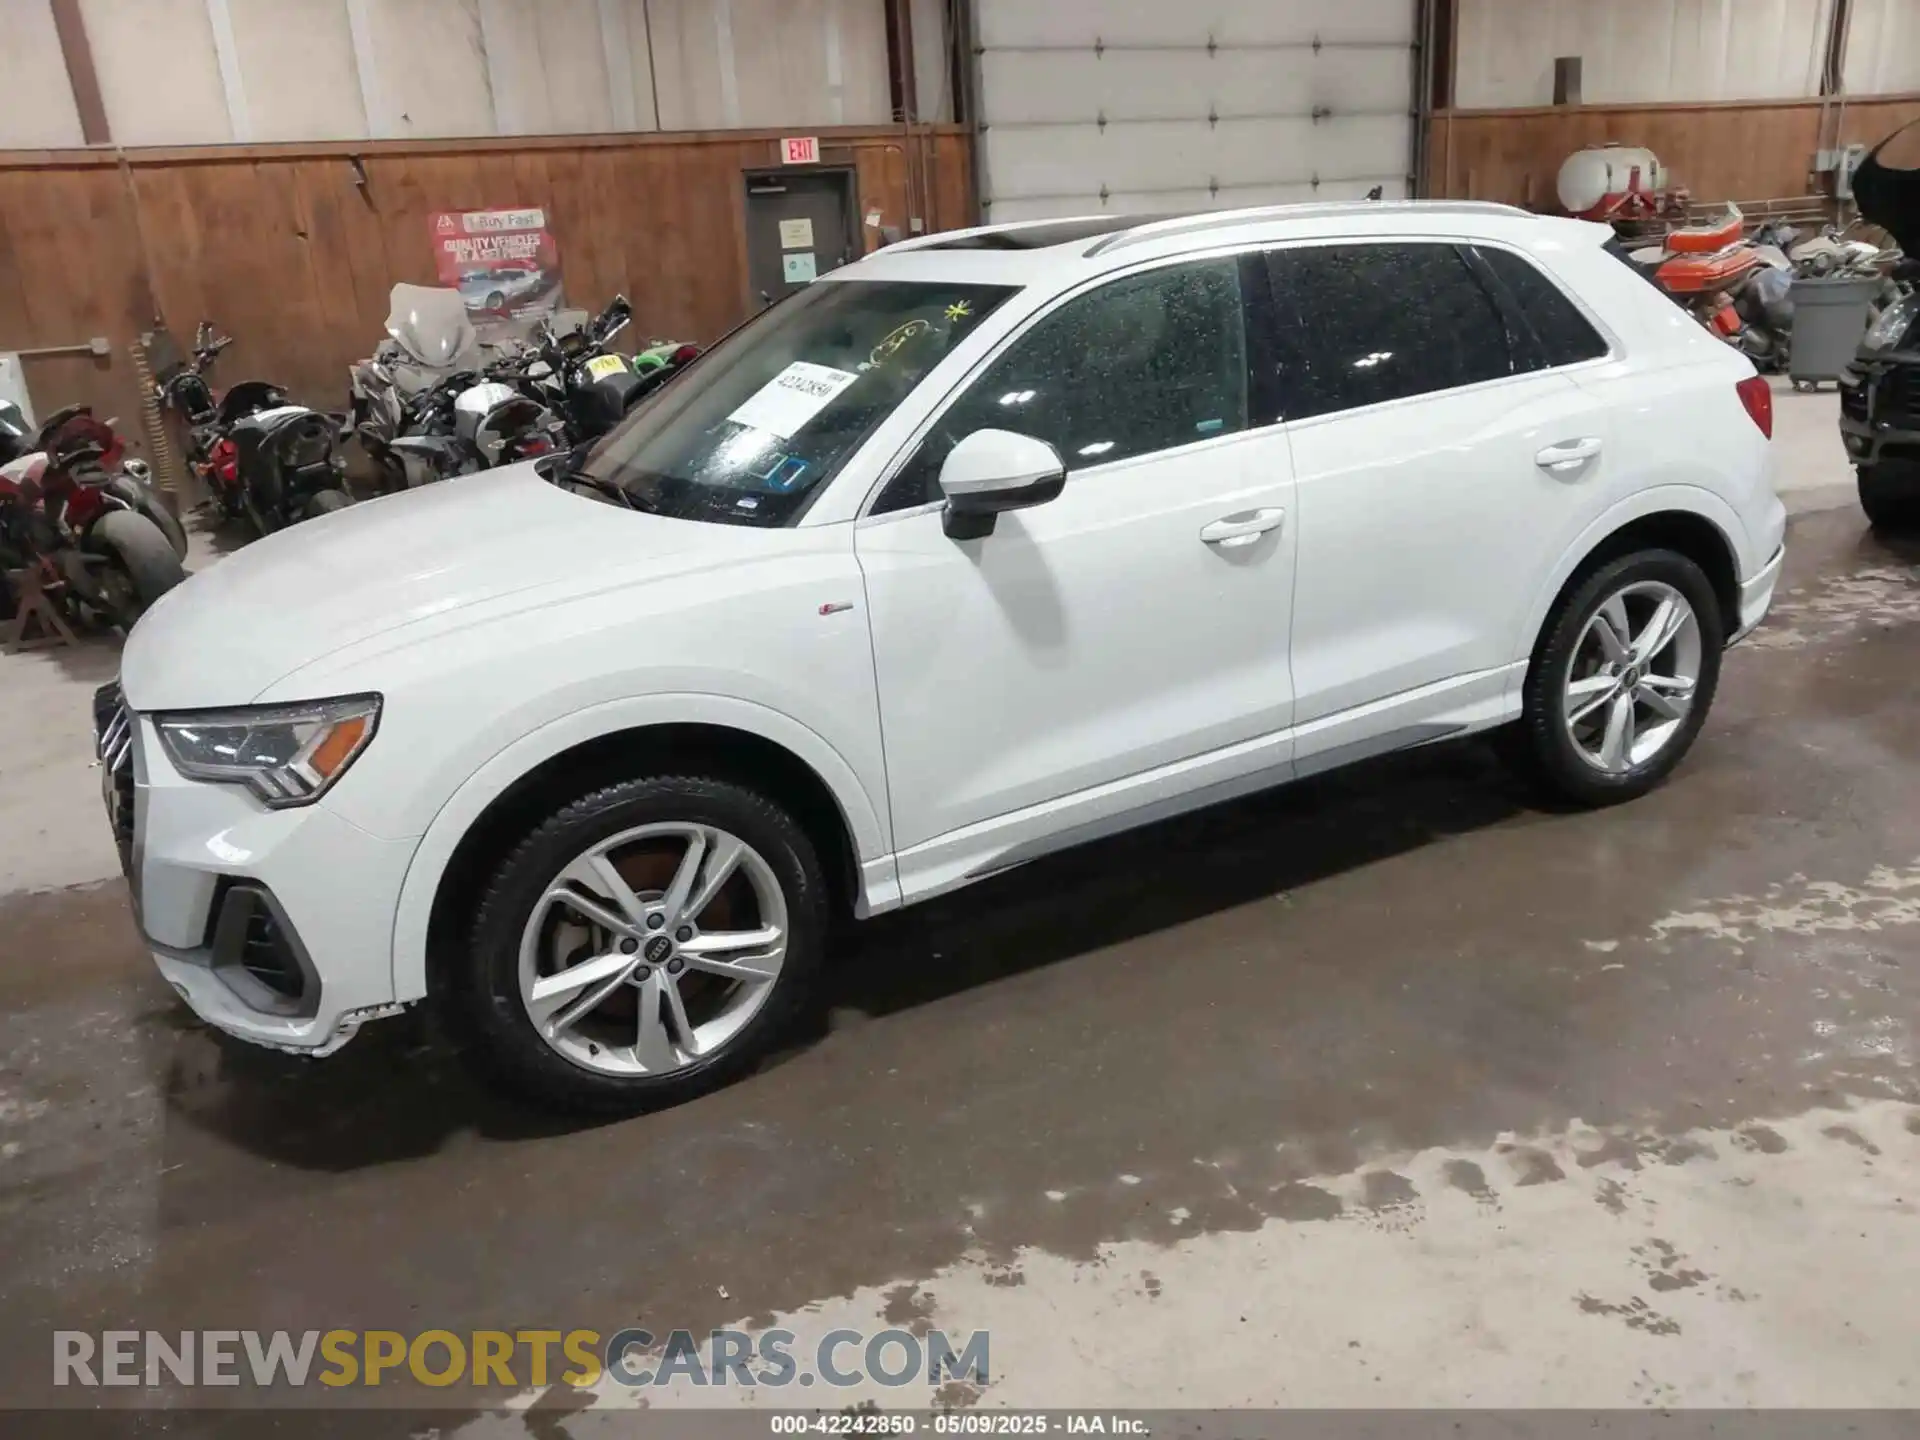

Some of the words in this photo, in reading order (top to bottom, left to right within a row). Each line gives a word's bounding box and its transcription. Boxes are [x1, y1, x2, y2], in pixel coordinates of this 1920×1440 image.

[788, 139, 812, 160] EXIT
[507, 212, 534, 225] Fast
[443, 236, 489, 253] QUALITY
[490, 233, 541, 249] VEHICLES
